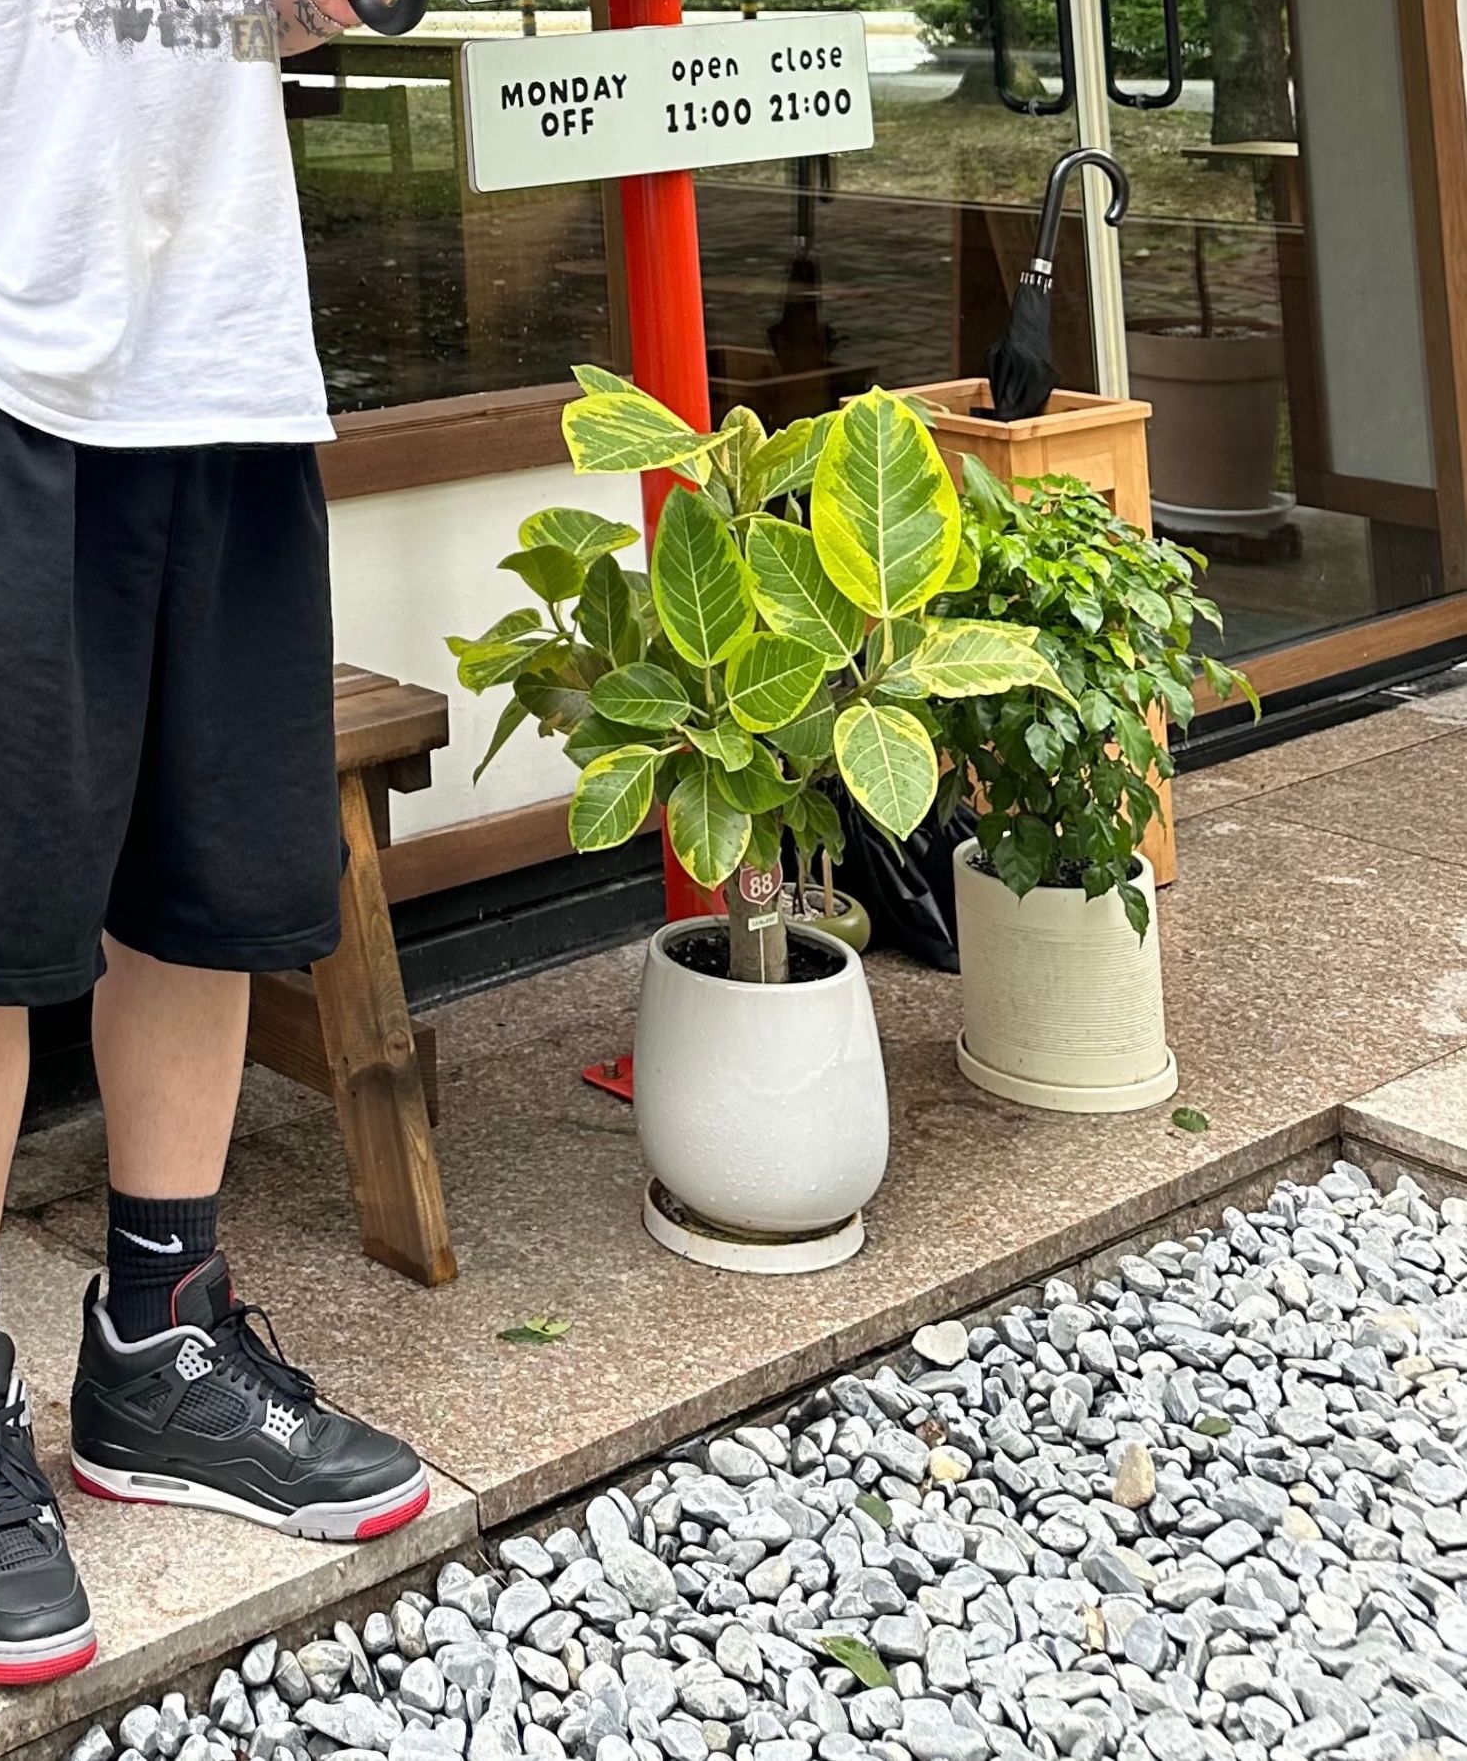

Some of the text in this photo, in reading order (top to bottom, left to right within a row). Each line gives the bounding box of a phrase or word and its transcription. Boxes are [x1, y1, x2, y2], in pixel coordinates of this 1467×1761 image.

[672, 46, 842, 87] open close
[501, 74, 627, 111] MONDAY
[666, 88, 851, 133] 11:00 21:00
[541, 107, 594, 137] OFF
[750, 872, 773, 898] 88
